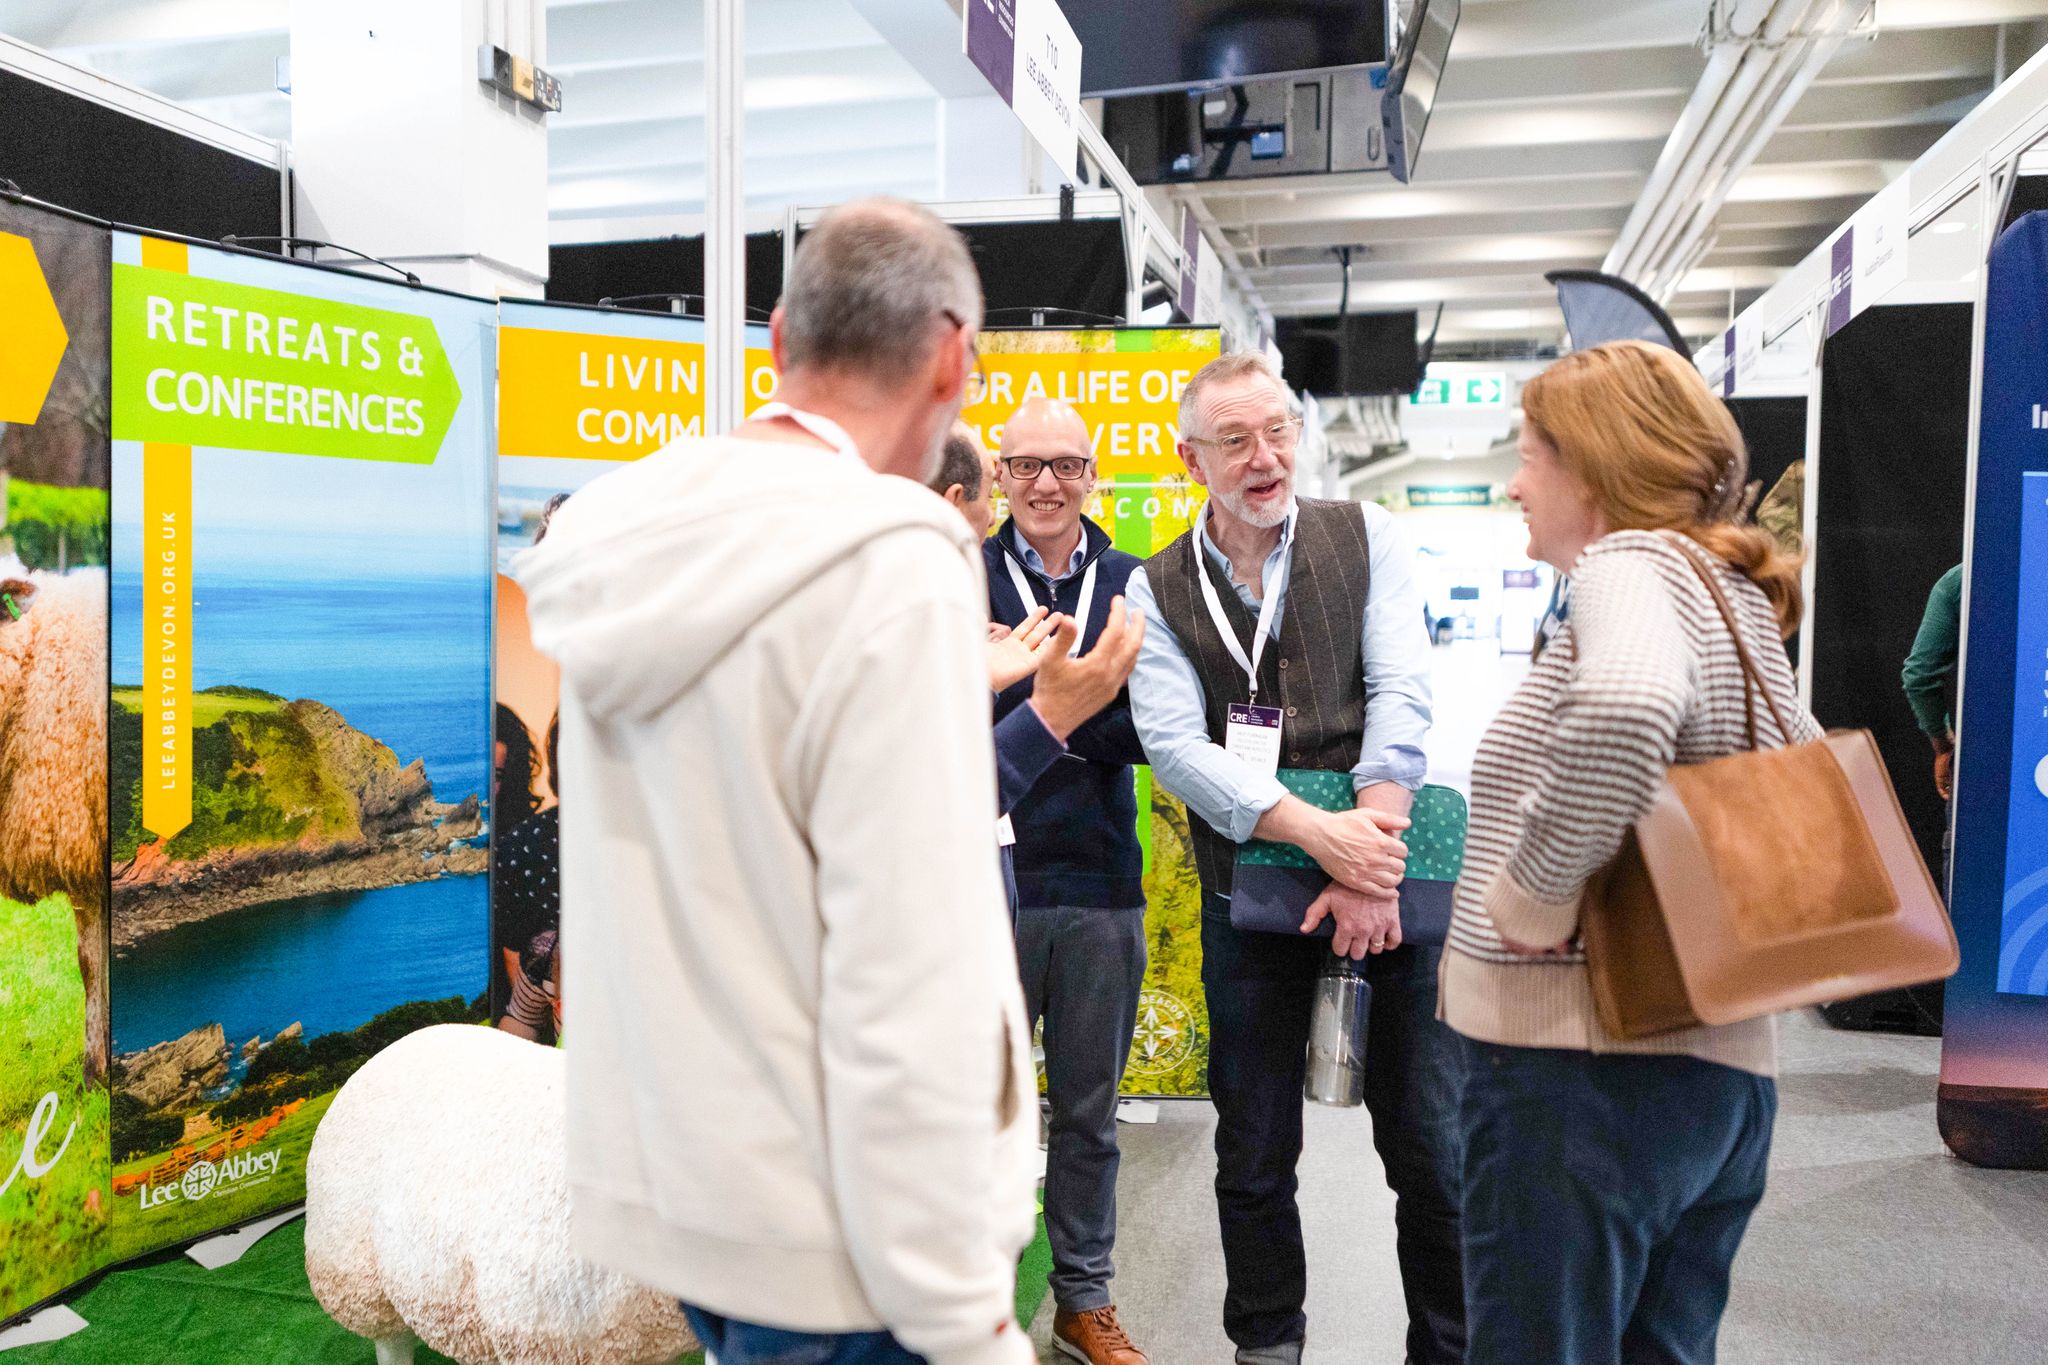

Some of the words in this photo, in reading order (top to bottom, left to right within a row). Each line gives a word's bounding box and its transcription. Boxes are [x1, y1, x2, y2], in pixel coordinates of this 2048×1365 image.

[1046, 33, 1059, 70] T10
[1025, 52, 1037, 82] LEE
[1037, 69, 1055, 103] ABBEY
[147, 296, 380, 369] RETREATS
[398, 338, 423, 377] &
[580, 352, 698, 395] LIVIN
[966, 371, 1015, 405] OR
[1021, 371, 1048, 402] A
[1057, 371, 1131, 404] LIFE
[1139, 370, 1191, 404] OF
[146, 368, 424, 437] CONFERENCES
[577, 408, 701, 445] COMM
[1089, 496, 1194, 519] ACON
[162, 512, 177, 789] LEEABBEYDEVON.ORG.UK
[1230, 712, 1248, 724] CRE
[1140, 995, 1185, 1020] BEACON
[140, 1182, 179, 1210] Lee
[217, 1148, 282, 1185] Abbey
